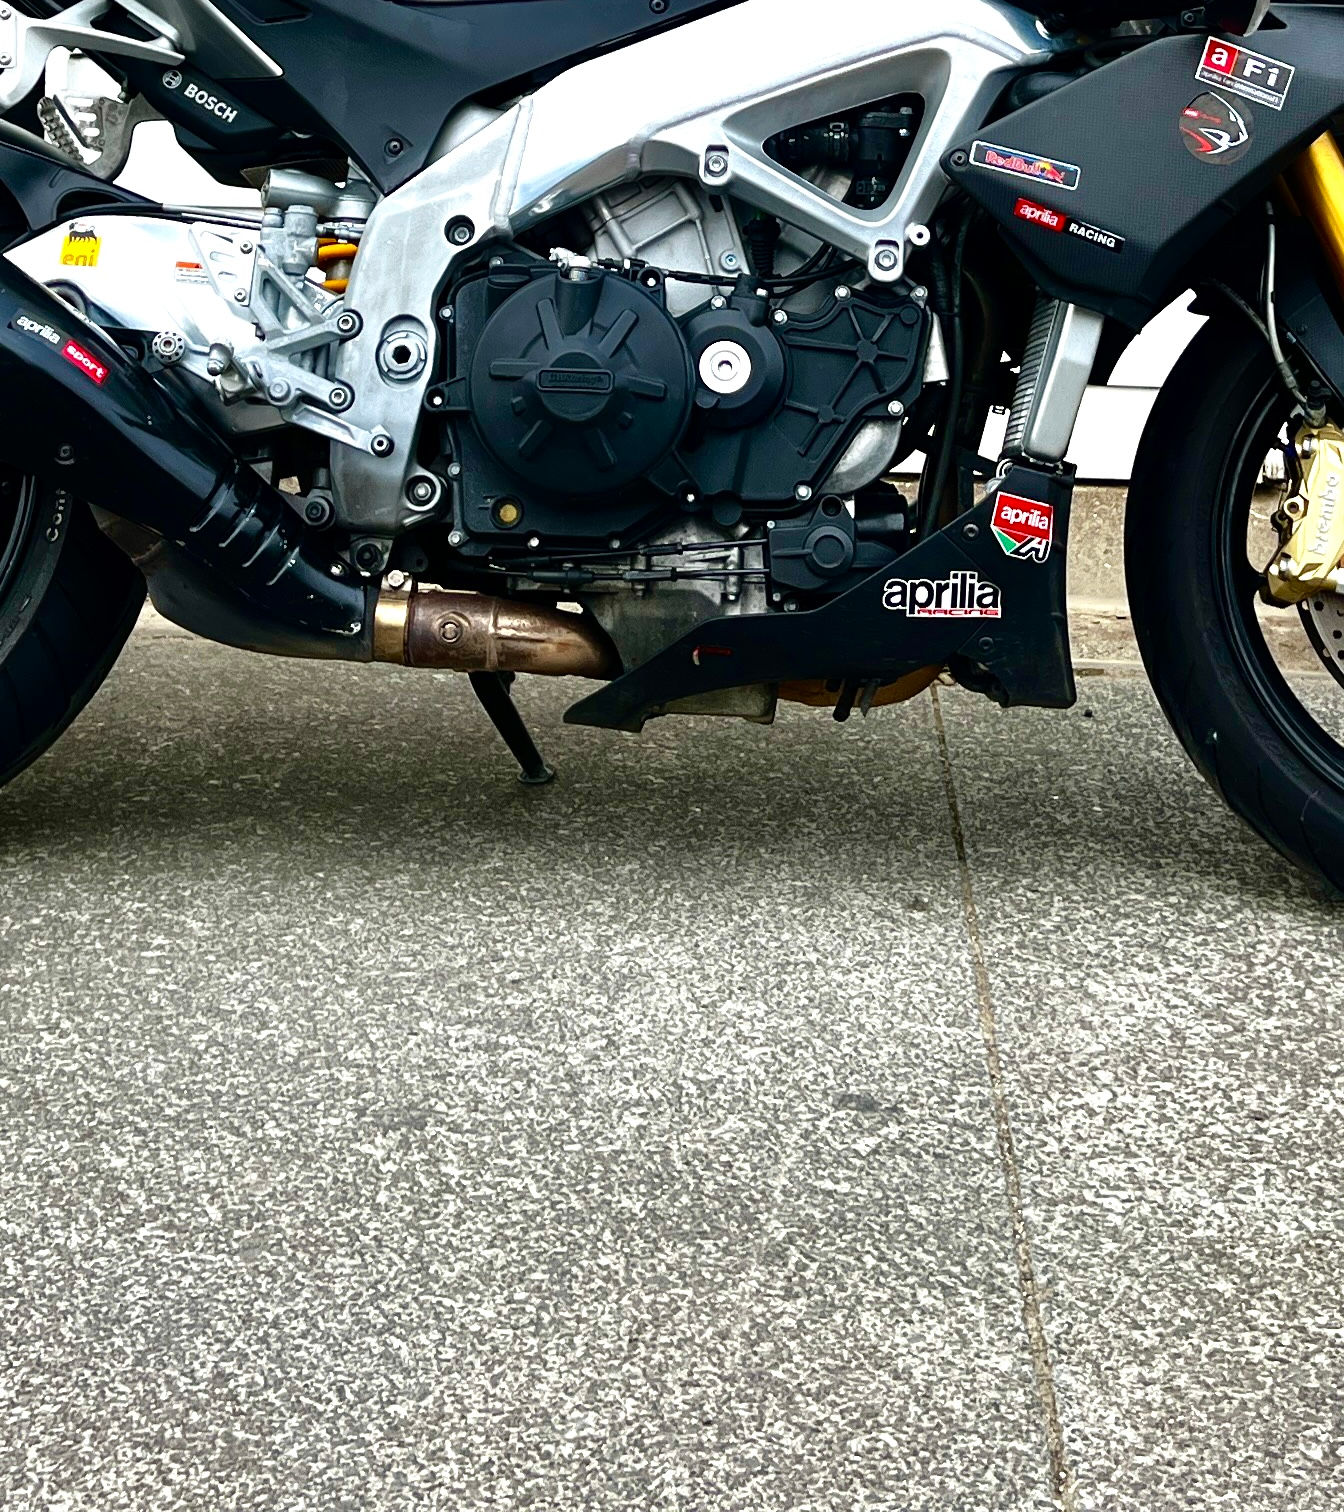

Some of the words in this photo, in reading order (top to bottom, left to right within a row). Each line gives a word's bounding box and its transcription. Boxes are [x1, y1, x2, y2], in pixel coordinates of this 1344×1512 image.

[1242, 57, 1280, 87] F1
[183, 83, 238, 123] BOSCH
[1019, 203, 1059, 229] aprilia
[1068, 223, 1116, 249] RACING
[63, 249, 95, 267] eni
[16, 315, 61, 345] aprilia
[67, 344, 106, 379] sport
[1000, 505, 1049, 530] aprilia
[1307, 475, 1337, 555] brembo
[883, 571, 1000, 616] aprilia
[916, 608, 999, 616] RACING
